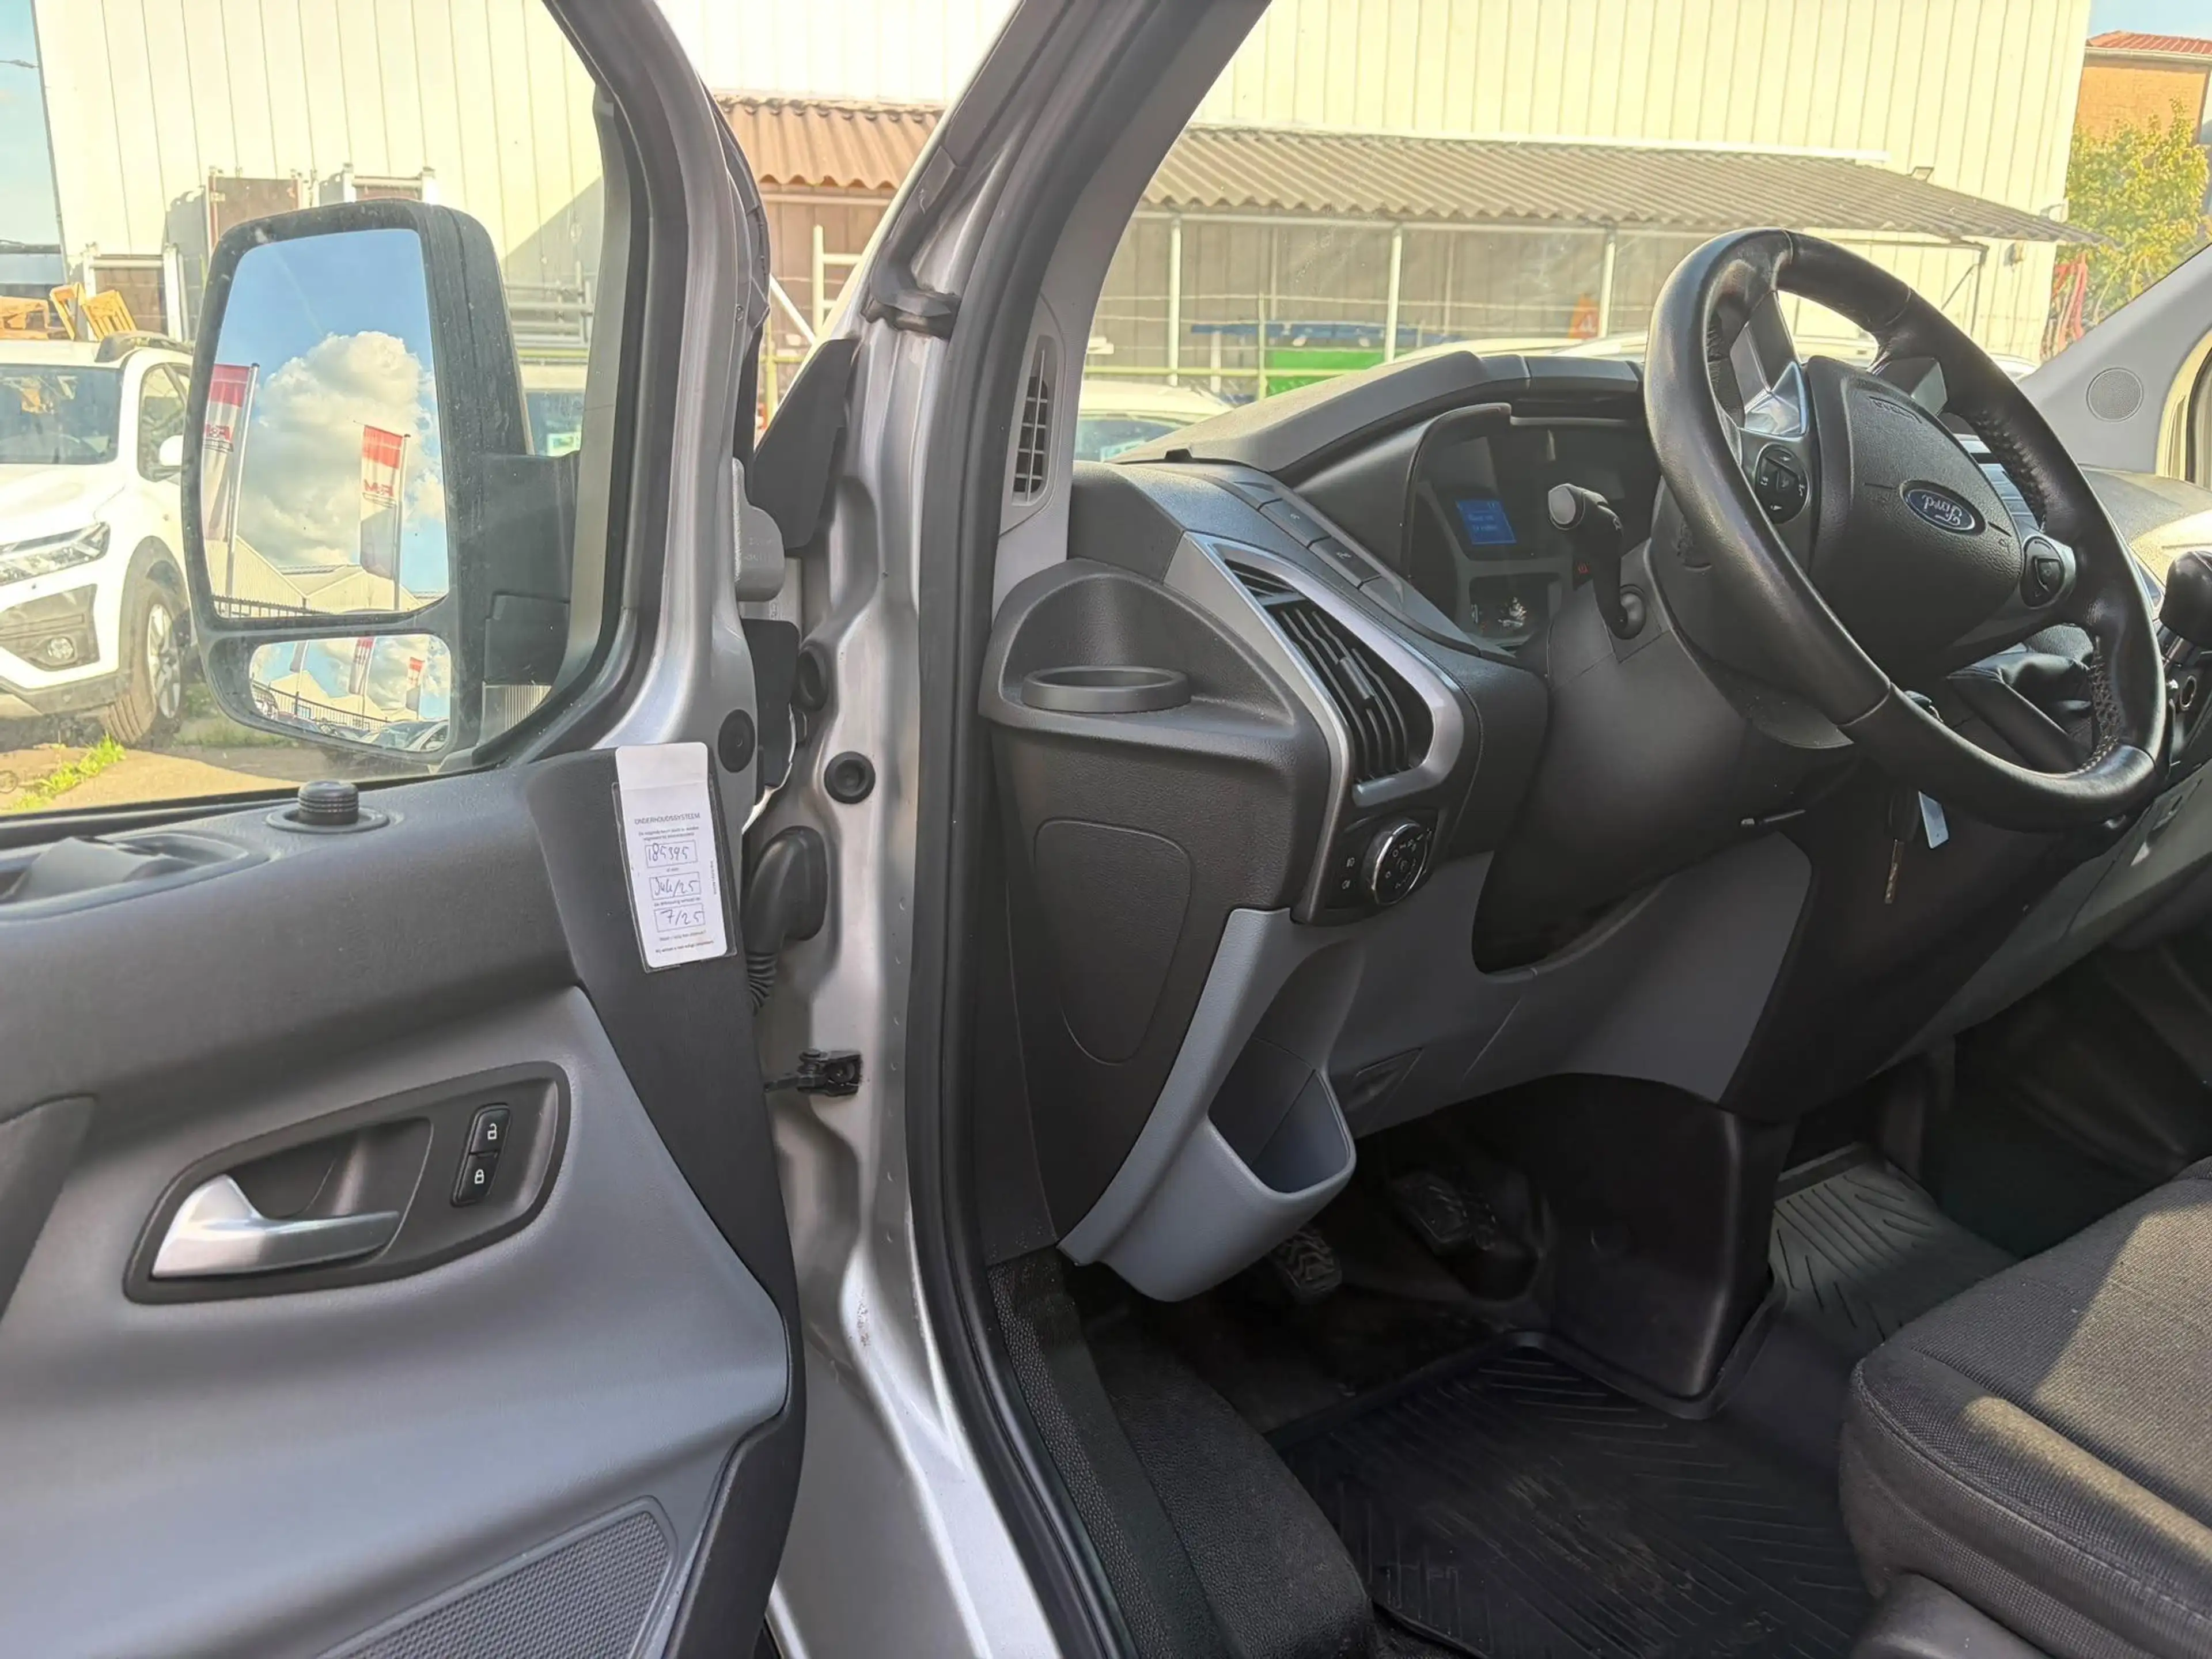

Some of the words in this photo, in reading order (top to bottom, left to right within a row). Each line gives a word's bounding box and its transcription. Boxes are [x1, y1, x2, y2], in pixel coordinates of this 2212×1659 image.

[1921, 493, 1963, 526] Ford
[634, 812, 701, 825] ONDERHOUDSSYSTEEM
[660, 909, 705, 926] 7/25
